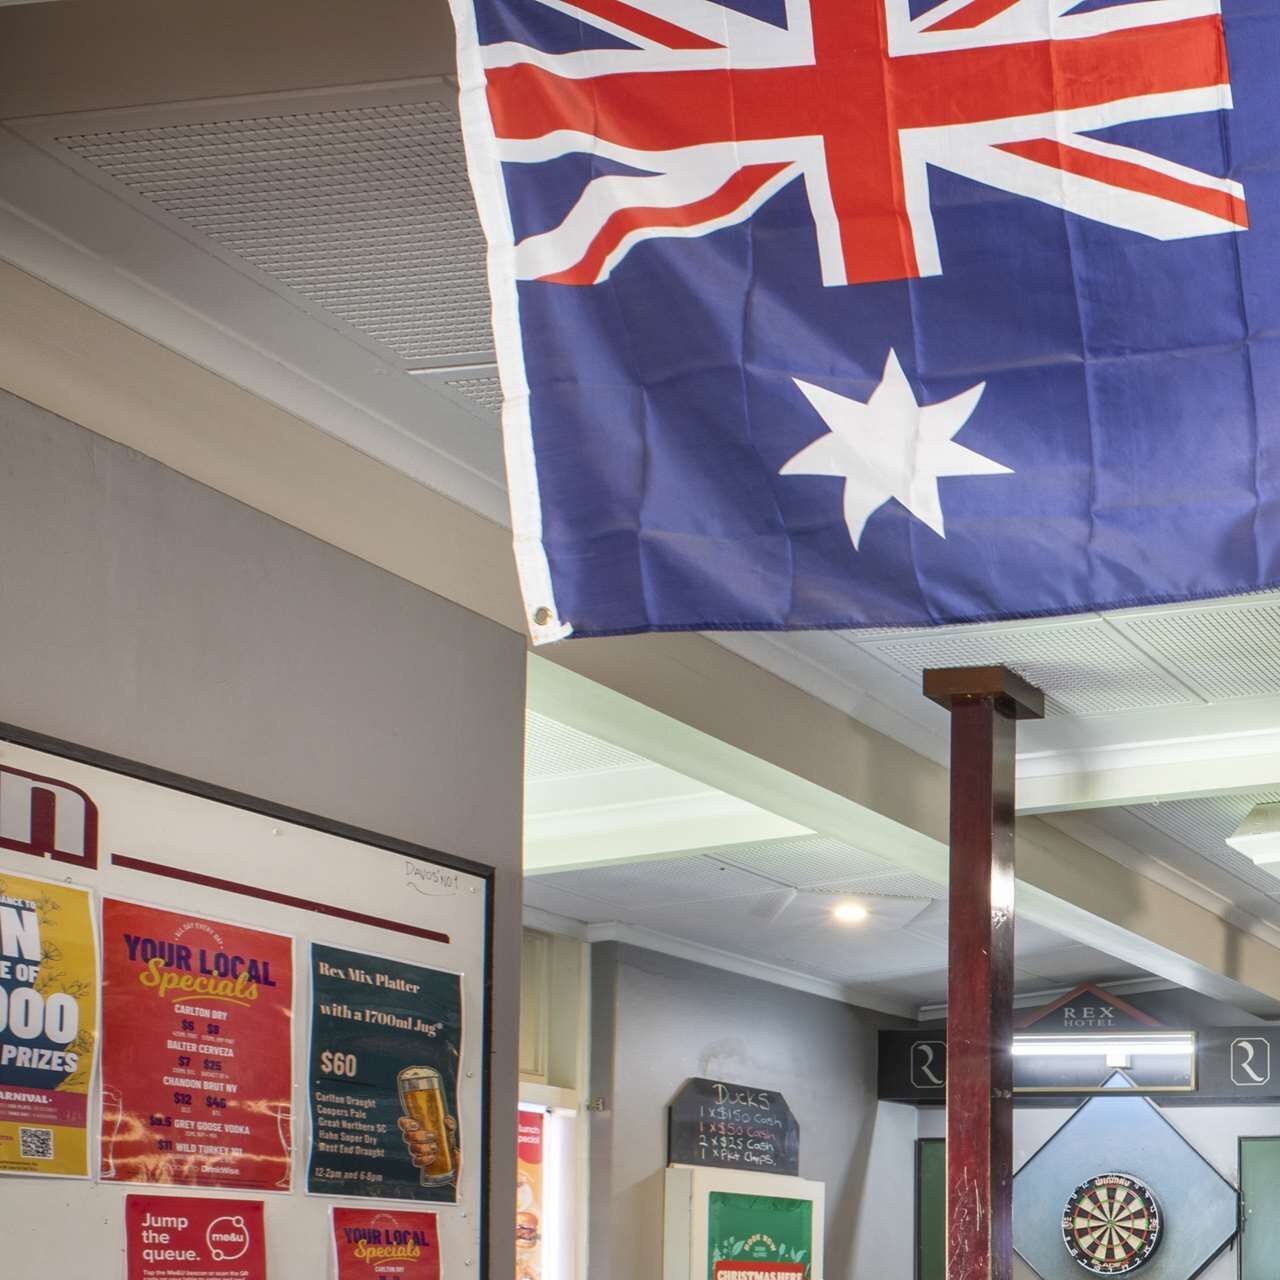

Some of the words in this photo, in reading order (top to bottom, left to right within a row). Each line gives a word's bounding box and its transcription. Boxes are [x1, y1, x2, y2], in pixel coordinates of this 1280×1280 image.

[124, 934, 192, 972] YOUR
[199, 948, 276, 986] LOCAL
[16, 964, 39, 983] OF
[139, 957, 258, 1000] Specials
[319, 961, 345, 979] Rex
[348, 967, 373, 984] Mix
[375, 973, 421, 994] Platter
[174, 1004, 210, 1019] CARLTON
[211, 1009, 228, 1021] DRY
[320, 1002, 352, 1019] with
[353, 1011, 363, 1022] a
[365, 1009, 412, 1030] 1700ml
[1064, 1007, 1115, 1019] REX
[1064, 1019, 1115, 1027] HOTEL
[167, 1039, 197, 1053] BALTER
[199, 1043, 234, 1057] CERVEZA
[2, 1045, 78, 1073] PRIZES
[320, 1049, 357, 1077] $60
[163, 1076, 202, 1090] CHANDON
[203, 1081, 225, 1092] BRUT
[0, 1090, 49, 1104] ARNIVAL
[315, 1092, 345, 1104] Carlton
[346, 1096, 376, 1109] Draught
[317, 1105, 348, 1117] Coopers
[174, 1119, 195, 1130] GREY
[318, 1117, 340, 1128] Great
[753, 1113, 782, 1128] Cash
[365, 1134, 377, 1146] Dry
[747, 1127, 776, 1141] Cash
[176, 1142, 196, 1153] WILD
[746, 1138, 774, 1151] Cash
[141, 1212, 189, 1231] Jump
[142, 1229, 170, 1244] the
[211, 1232, 245, 1242] me&u
[344, 1227, 382, 1245] YOUR
[384, 1229, 430, 1247] LOCAL
[142, 1249, 201, 1263] queue.
[354, 1239, 421, 1264] Specials
